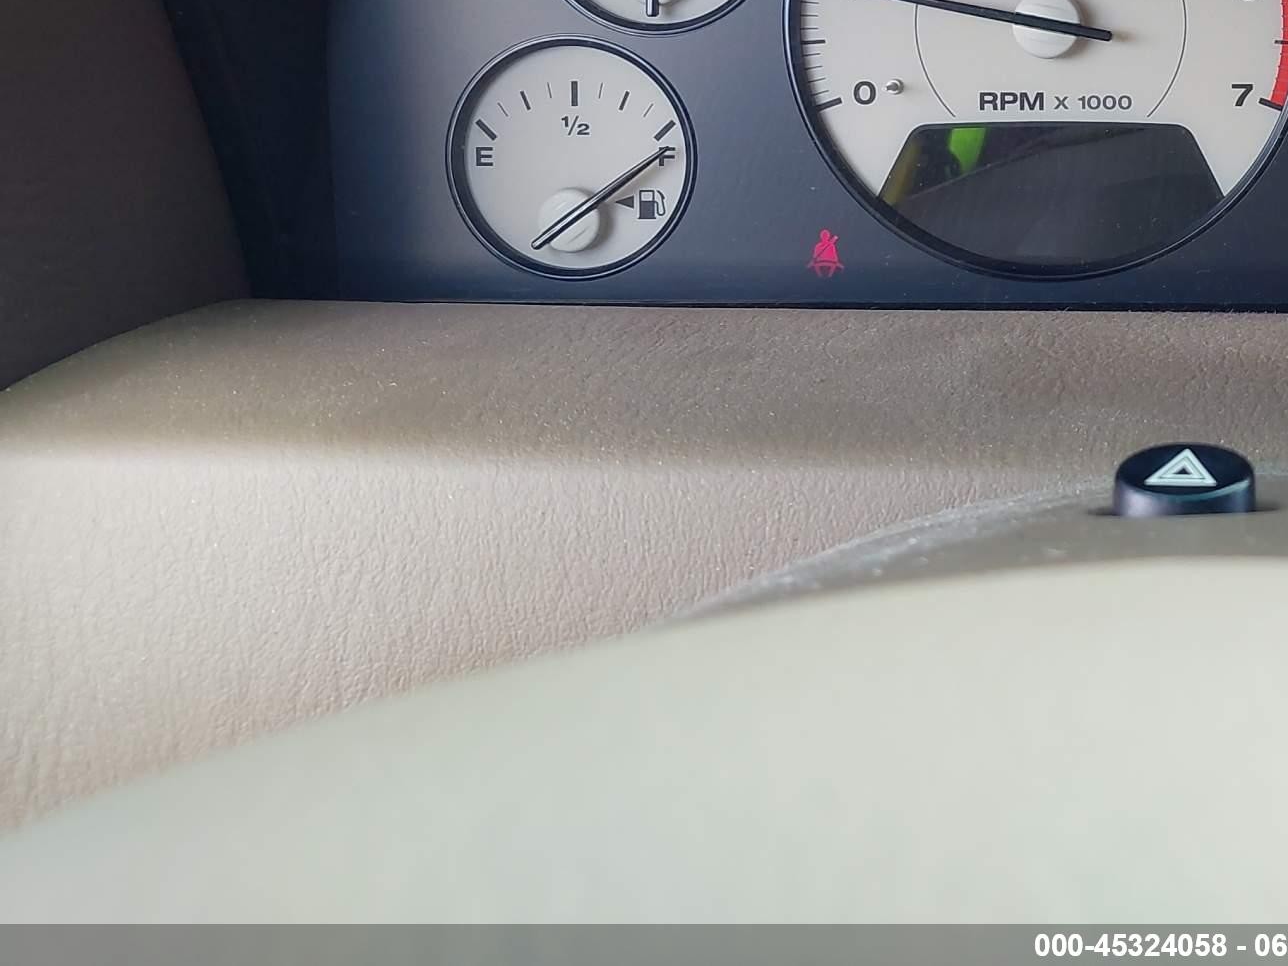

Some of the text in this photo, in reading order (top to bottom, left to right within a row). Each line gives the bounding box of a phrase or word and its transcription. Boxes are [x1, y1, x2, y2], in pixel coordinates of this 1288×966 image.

[853, 80, 877, 105] 0
[979, 91, 1044, 111] RPM
[1077, 94, 1132, 111] 1000
[1231, 83, 1254, 107] 7
[475, 146, 494, 167] E
